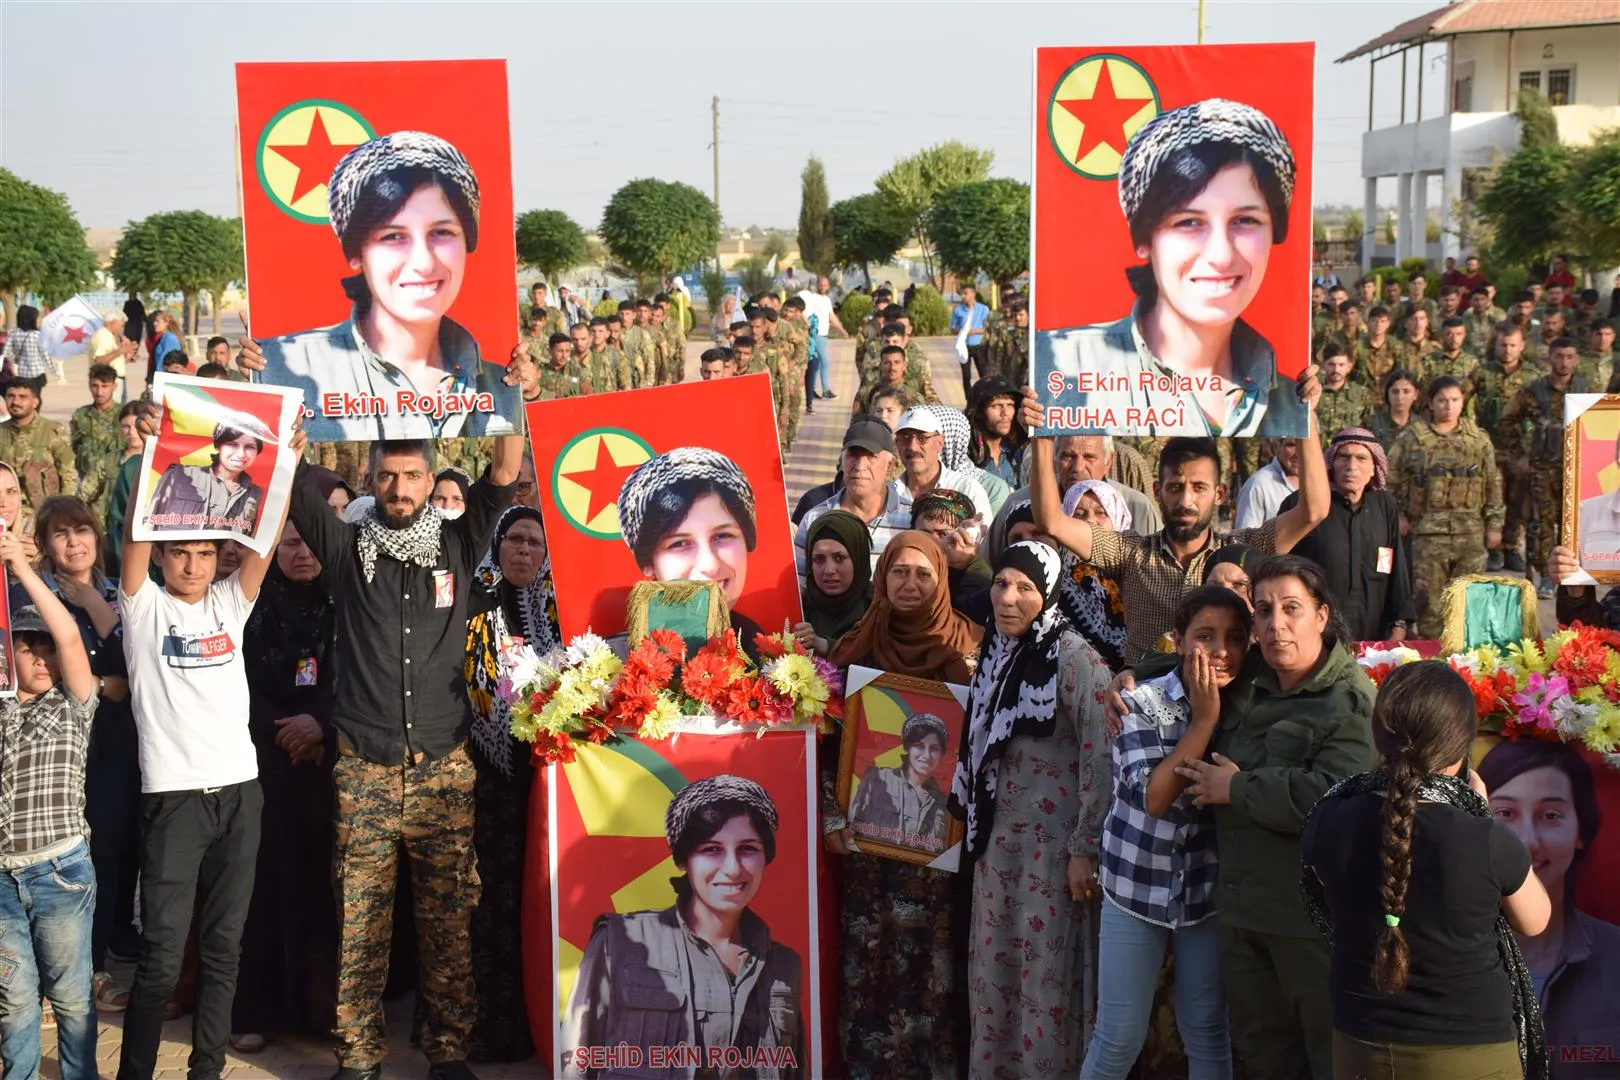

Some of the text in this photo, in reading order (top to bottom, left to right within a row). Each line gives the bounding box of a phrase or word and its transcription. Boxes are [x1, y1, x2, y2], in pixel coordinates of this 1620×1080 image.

[1047, 370, 1223, 398] Ş. Ekîn Rojava
[323, 390, 386, 416] Ekîn
[396, 389, 494, 420] Rojava
[1047, 399, 1185, 429] RUHA RACÎ
[575, 1041, 798, 1073] ŞEHÎD EKÎN ROJAVA
